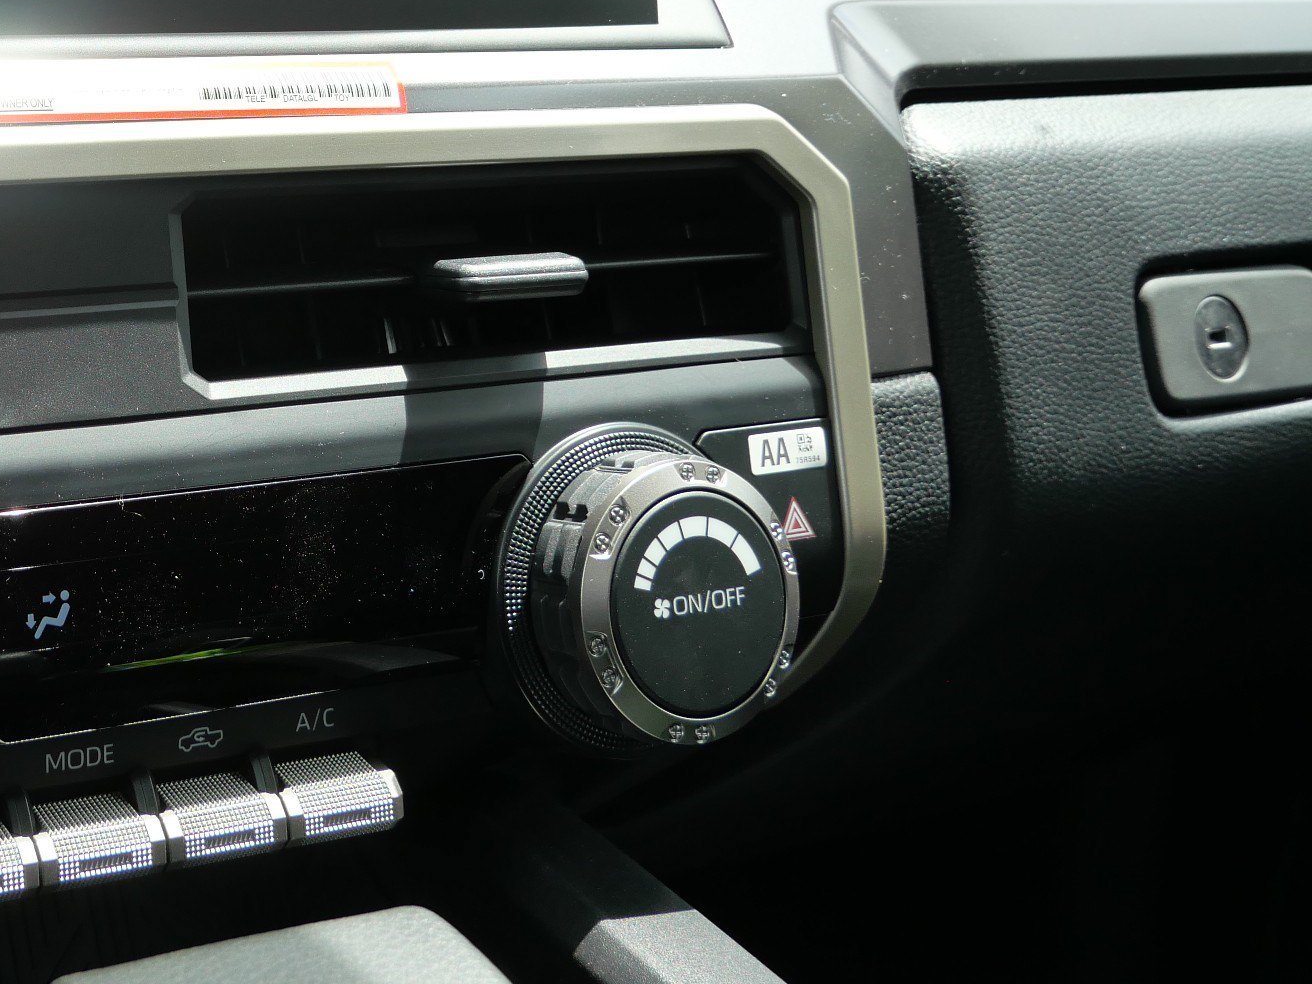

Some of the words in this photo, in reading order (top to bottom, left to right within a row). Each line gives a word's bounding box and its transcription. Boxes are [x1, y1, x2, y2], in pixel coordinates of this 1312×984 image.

[30, 97, 54, 109] ONLY
[244, 94, 267, 103] TELE
[760, 437, 791, 468] AA
[672, 585, 746, 616] ON/OFF
[294, 706, 335, 734] A/C
[44, 742, 116, 774] MODE
